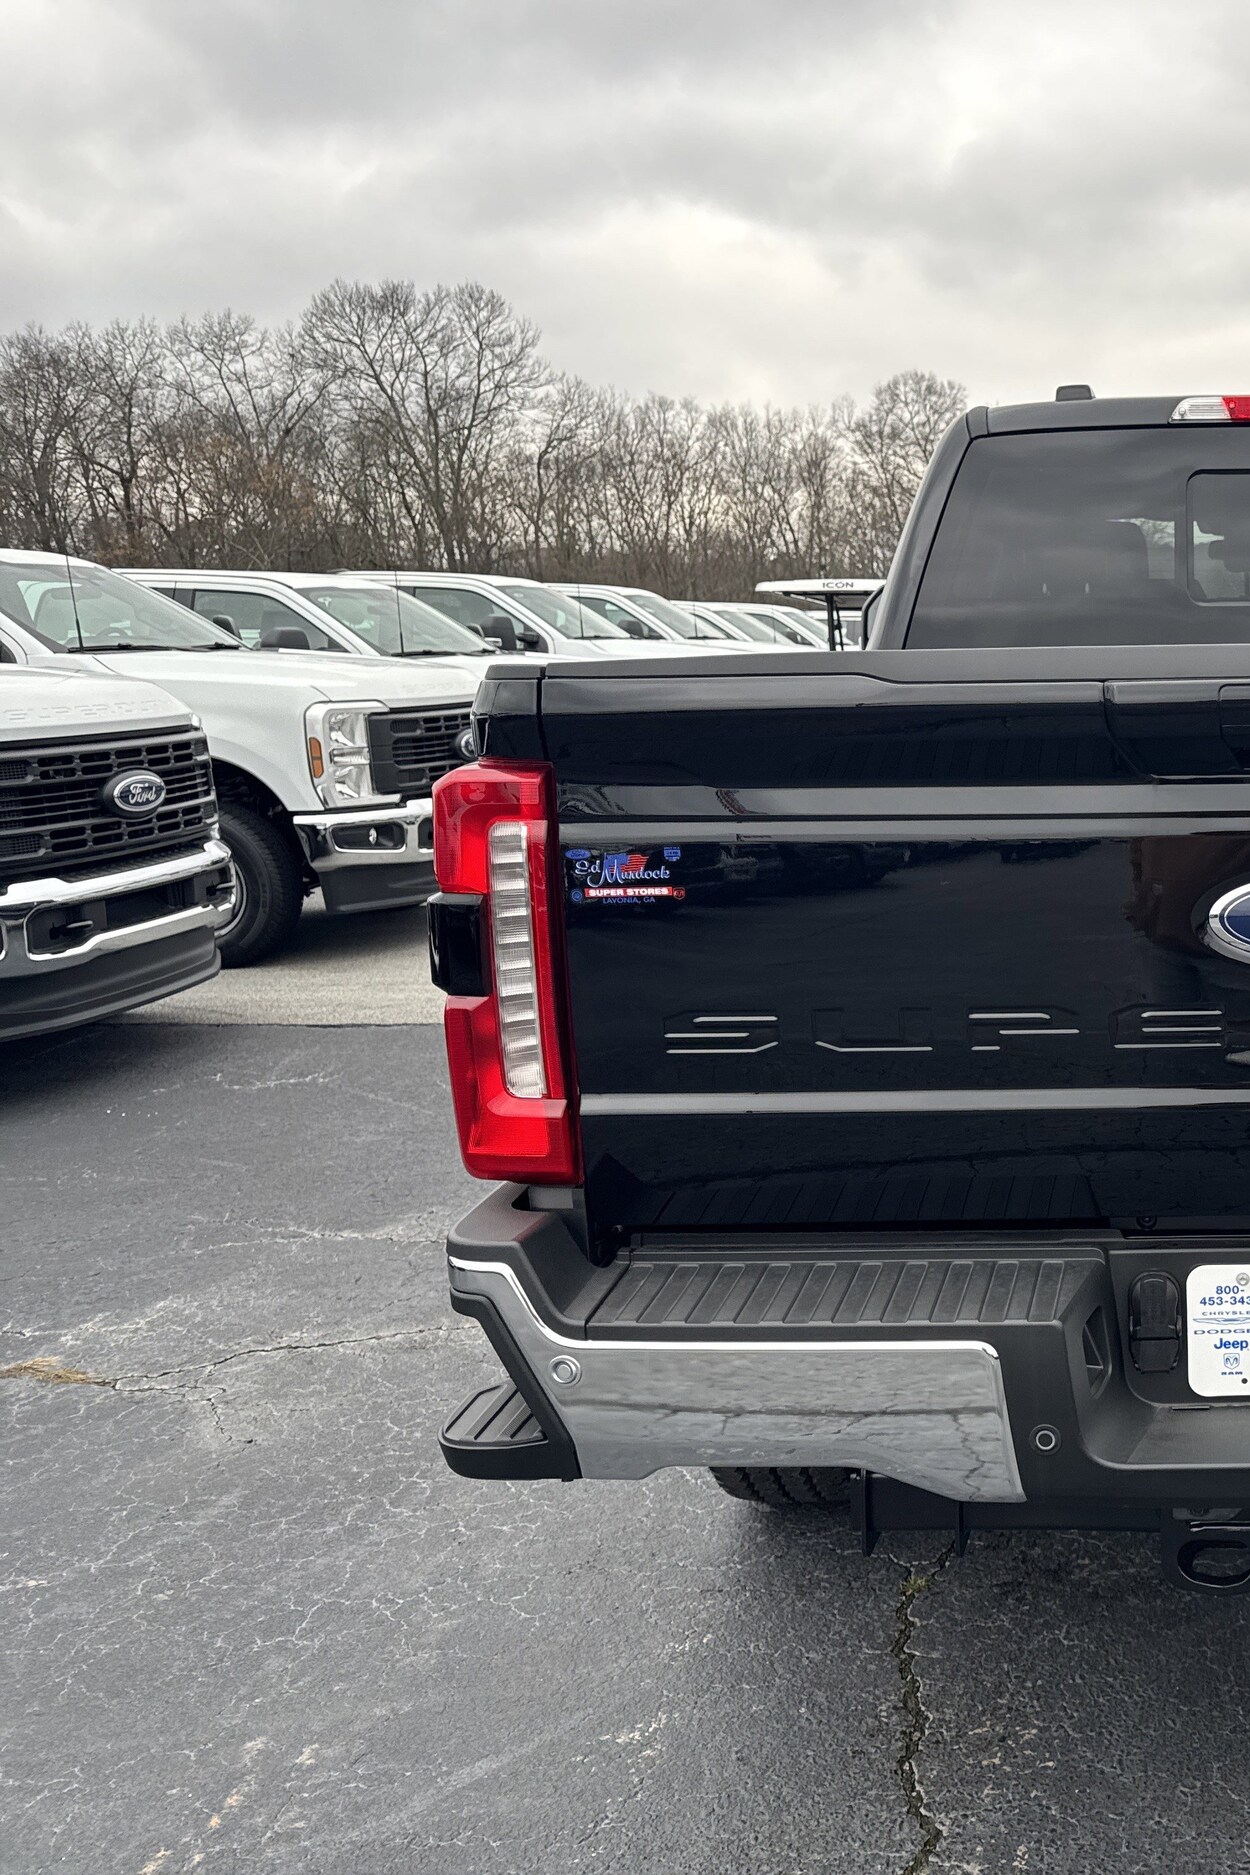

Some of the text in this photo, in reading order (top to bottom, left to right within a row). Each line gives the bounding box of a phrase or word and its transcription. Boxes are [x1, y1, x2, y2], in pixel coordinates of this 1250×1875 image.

[822, 581, 854, 589] ICON
[128, 782, 158, 804] Ford
[587, 858, 670, 888] Murdock
[588, 887, 669, 897] SUPER STORES
[1215, 1285, 1245, 1295] 800-
[1213, 1337, 1249, 1352] Jeep
